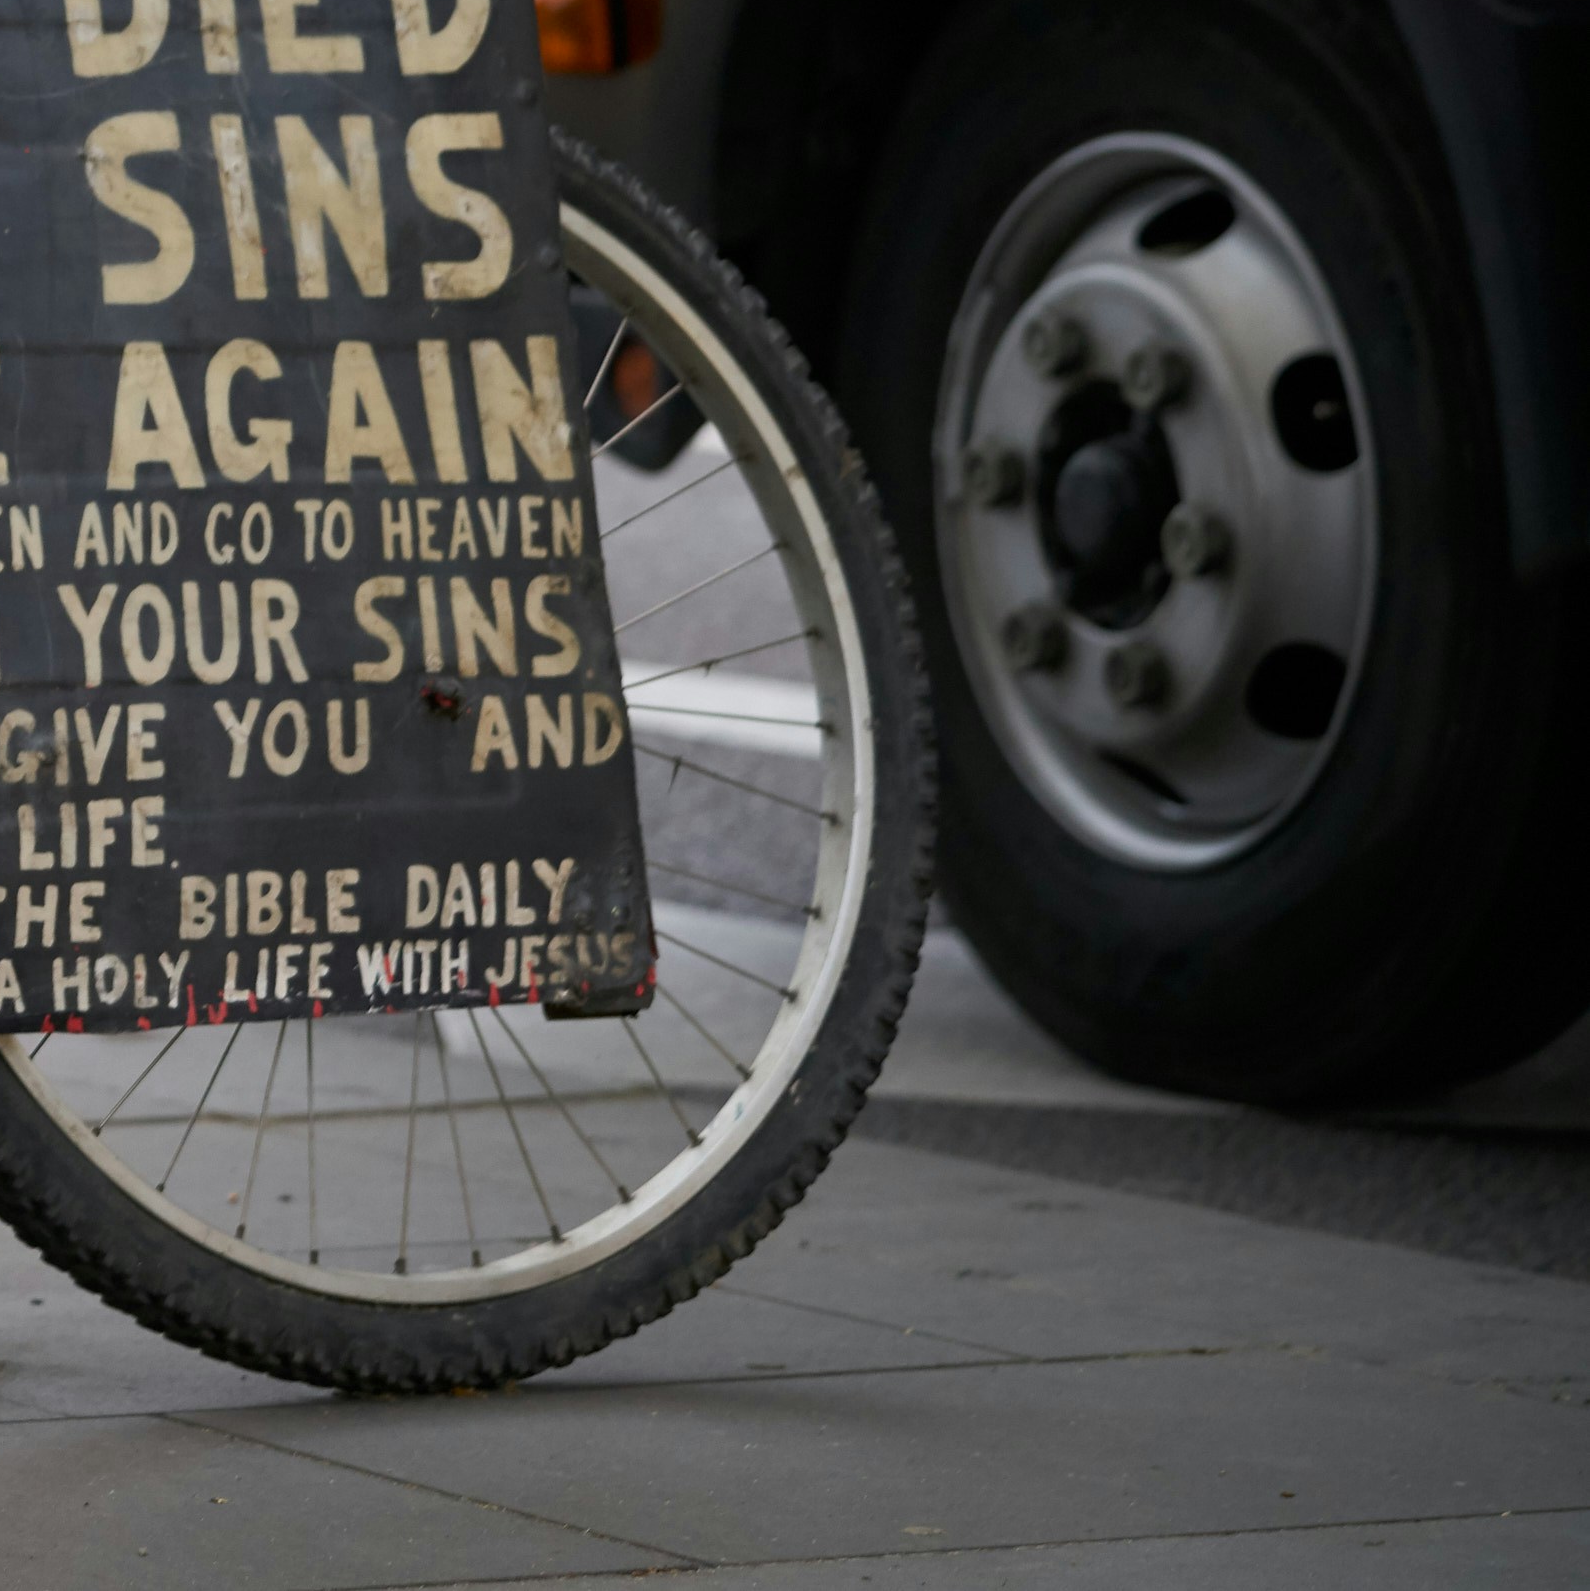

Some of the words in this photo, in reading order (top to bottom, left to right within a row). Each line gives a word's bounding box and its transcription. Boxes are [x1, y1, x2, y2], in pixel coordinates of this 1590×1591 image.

[83, 110, 513, 306] SINS
[106, 335, 574, 491] AGAIN
[73, 500, 179, 570] AND
[204, 501, 273, 565] GO
[294, 498, 354, 562] TO
[380, 495, 582, 562] HEAVEN
[57, 578, 309, 688] YOUR
[213, 698, 370, 779] YOU
[470, 690, 624, 773] AND
[17, 794, 182, 871] LIFE.
[179, 868, 360, 940] BIBLE
[406, 858, 574, 928] DAILY
[52, 950, 190, 1012] HOLY
[222, 942, 334, 1003] LIFE
[356, 939, 469, 996] WITH
[484, 933, 636, 989] JESUS
